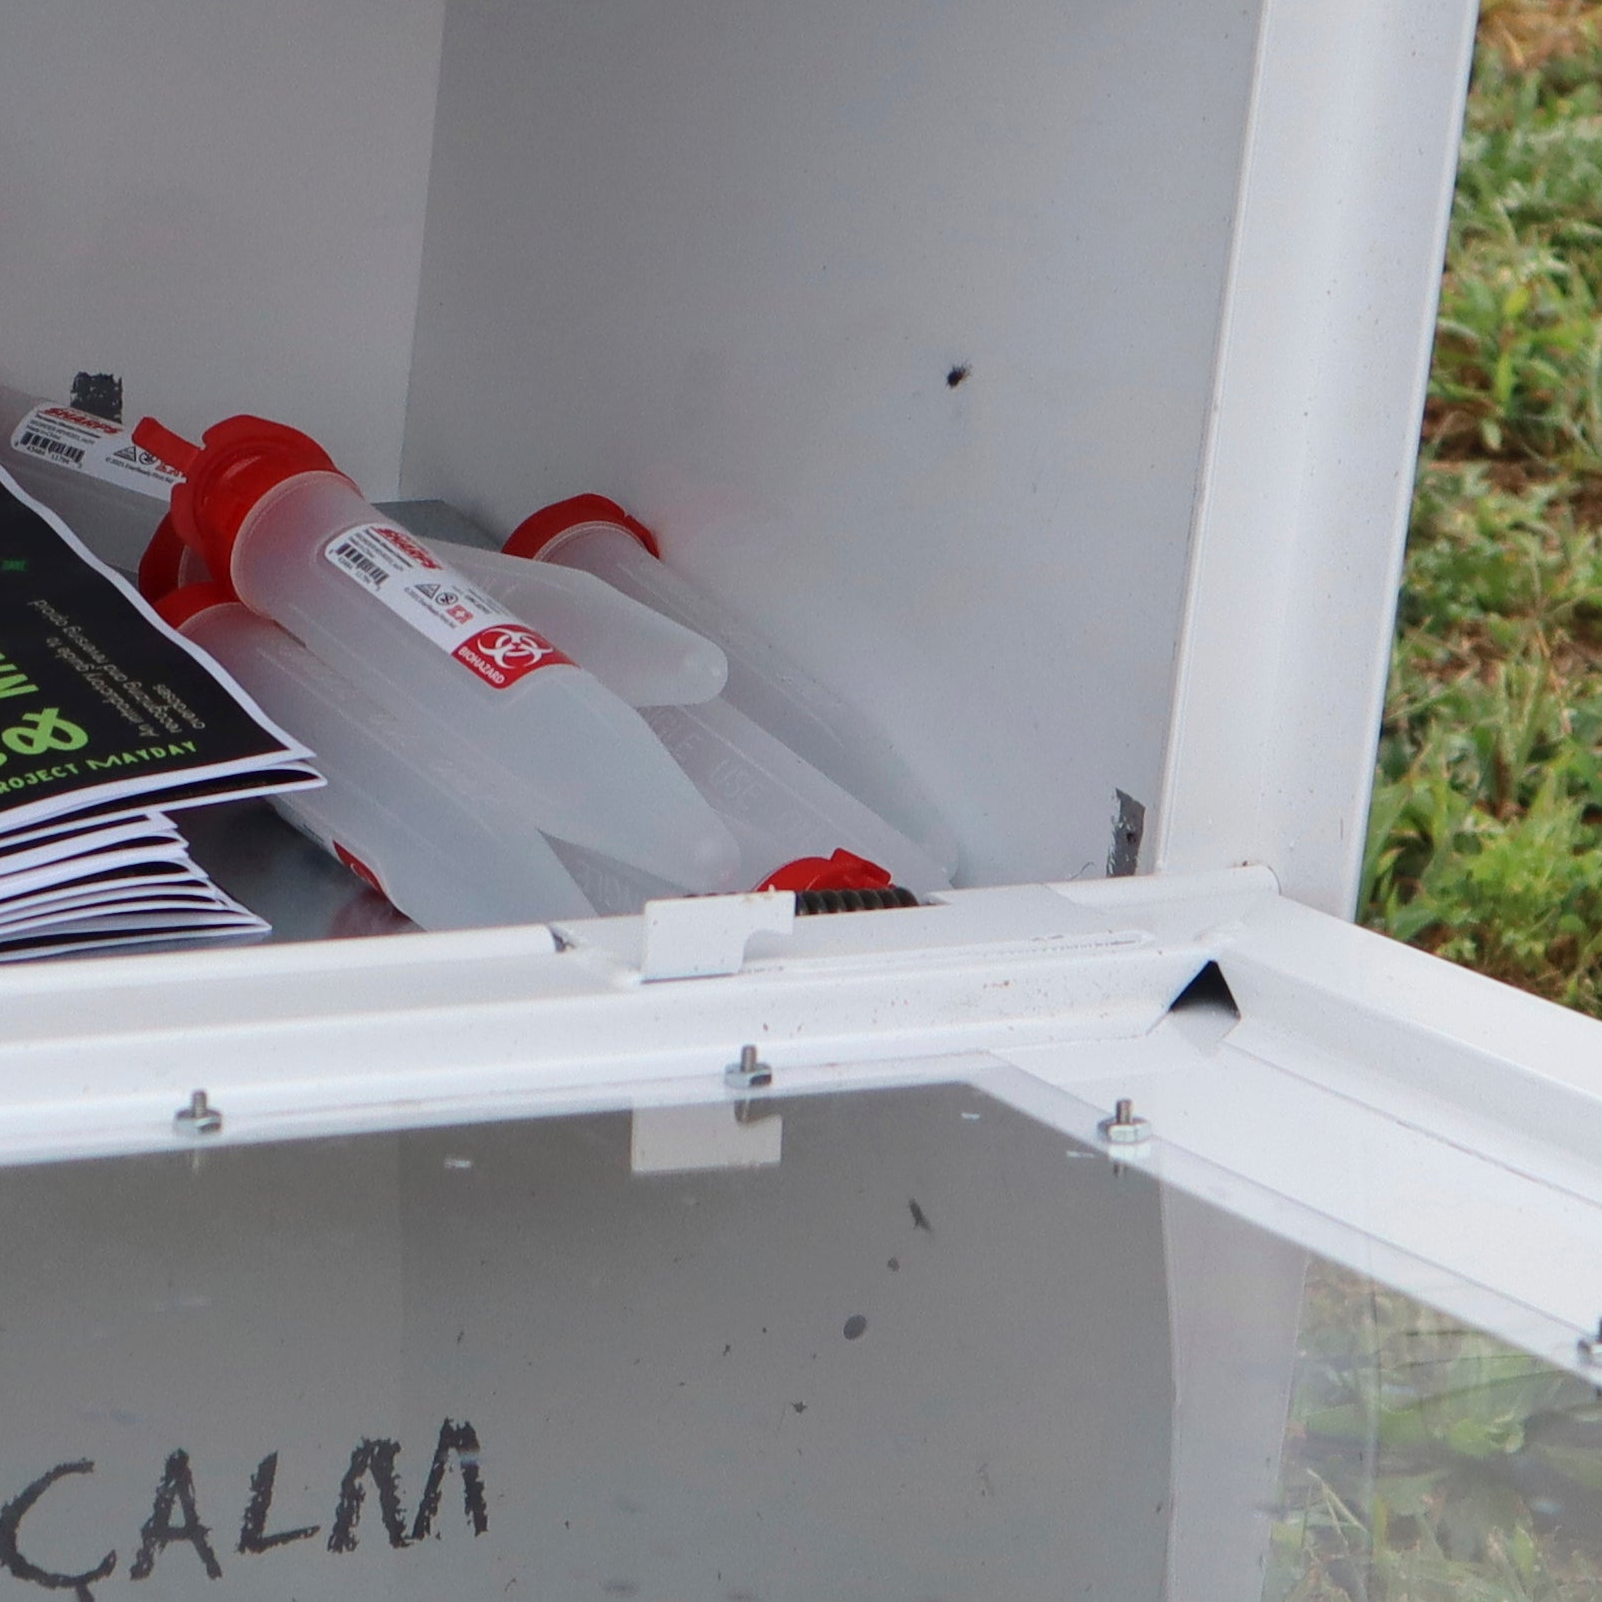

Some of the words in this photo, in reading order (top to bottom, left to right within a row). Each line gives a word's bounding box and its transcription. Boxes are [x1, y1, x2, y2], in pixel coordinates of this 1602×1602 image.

[27, 599, 69, 627] opioid
[46, 636, 63, 649] to
[62, 625, 109, 665] reversing
[56, 647, 95, 673] guide
[102, 663, 129, 683] and
[458, 646, 505, 684] BIOHAZARD
[85, 672, 145, 724] introductory
[123, 681, 182, 735] recognizing
[152, 683, 206, 730] overdoses
[2, 707, 88, 755] &
[138, 723, 160, 737] An
[86, 741, 197, 771] MAYDAY
